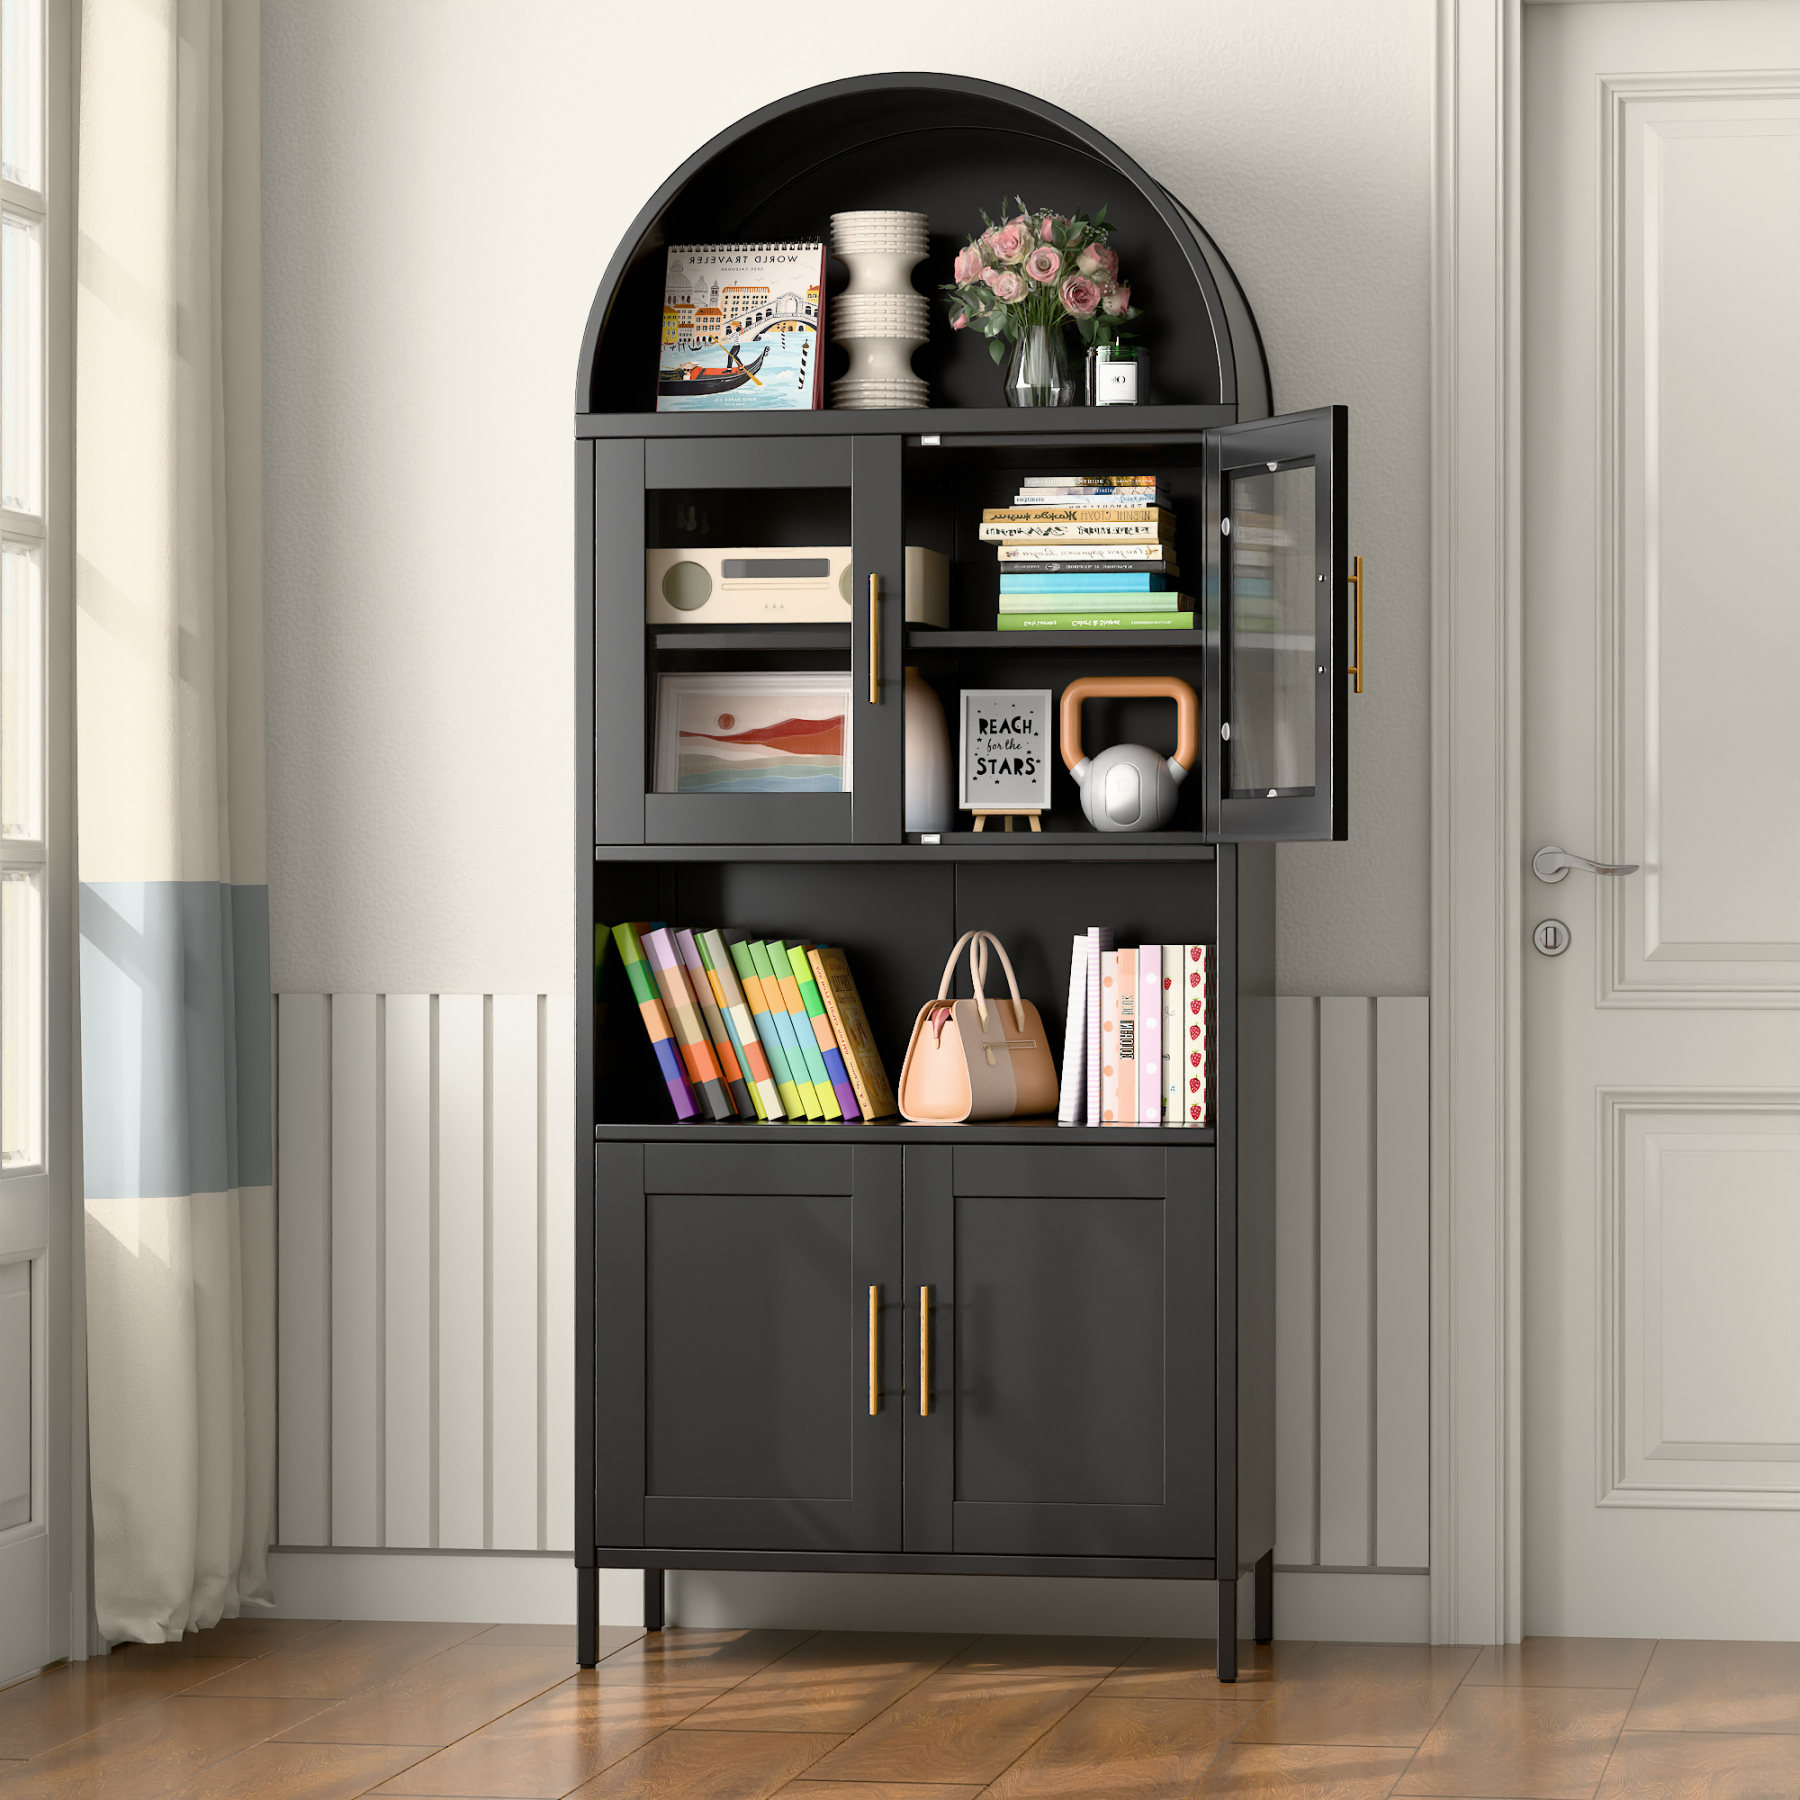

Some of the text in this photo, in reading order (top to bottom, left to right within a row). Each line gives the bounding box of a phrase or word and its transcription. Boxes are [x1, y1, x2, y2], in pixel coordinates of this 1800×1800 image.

[978, 716, 1033, 735] REACH
[987, 738, 1023, 753] for the
[976, 757, 1036, 776] STARS
[1114, 778, 1131, 792] 12
